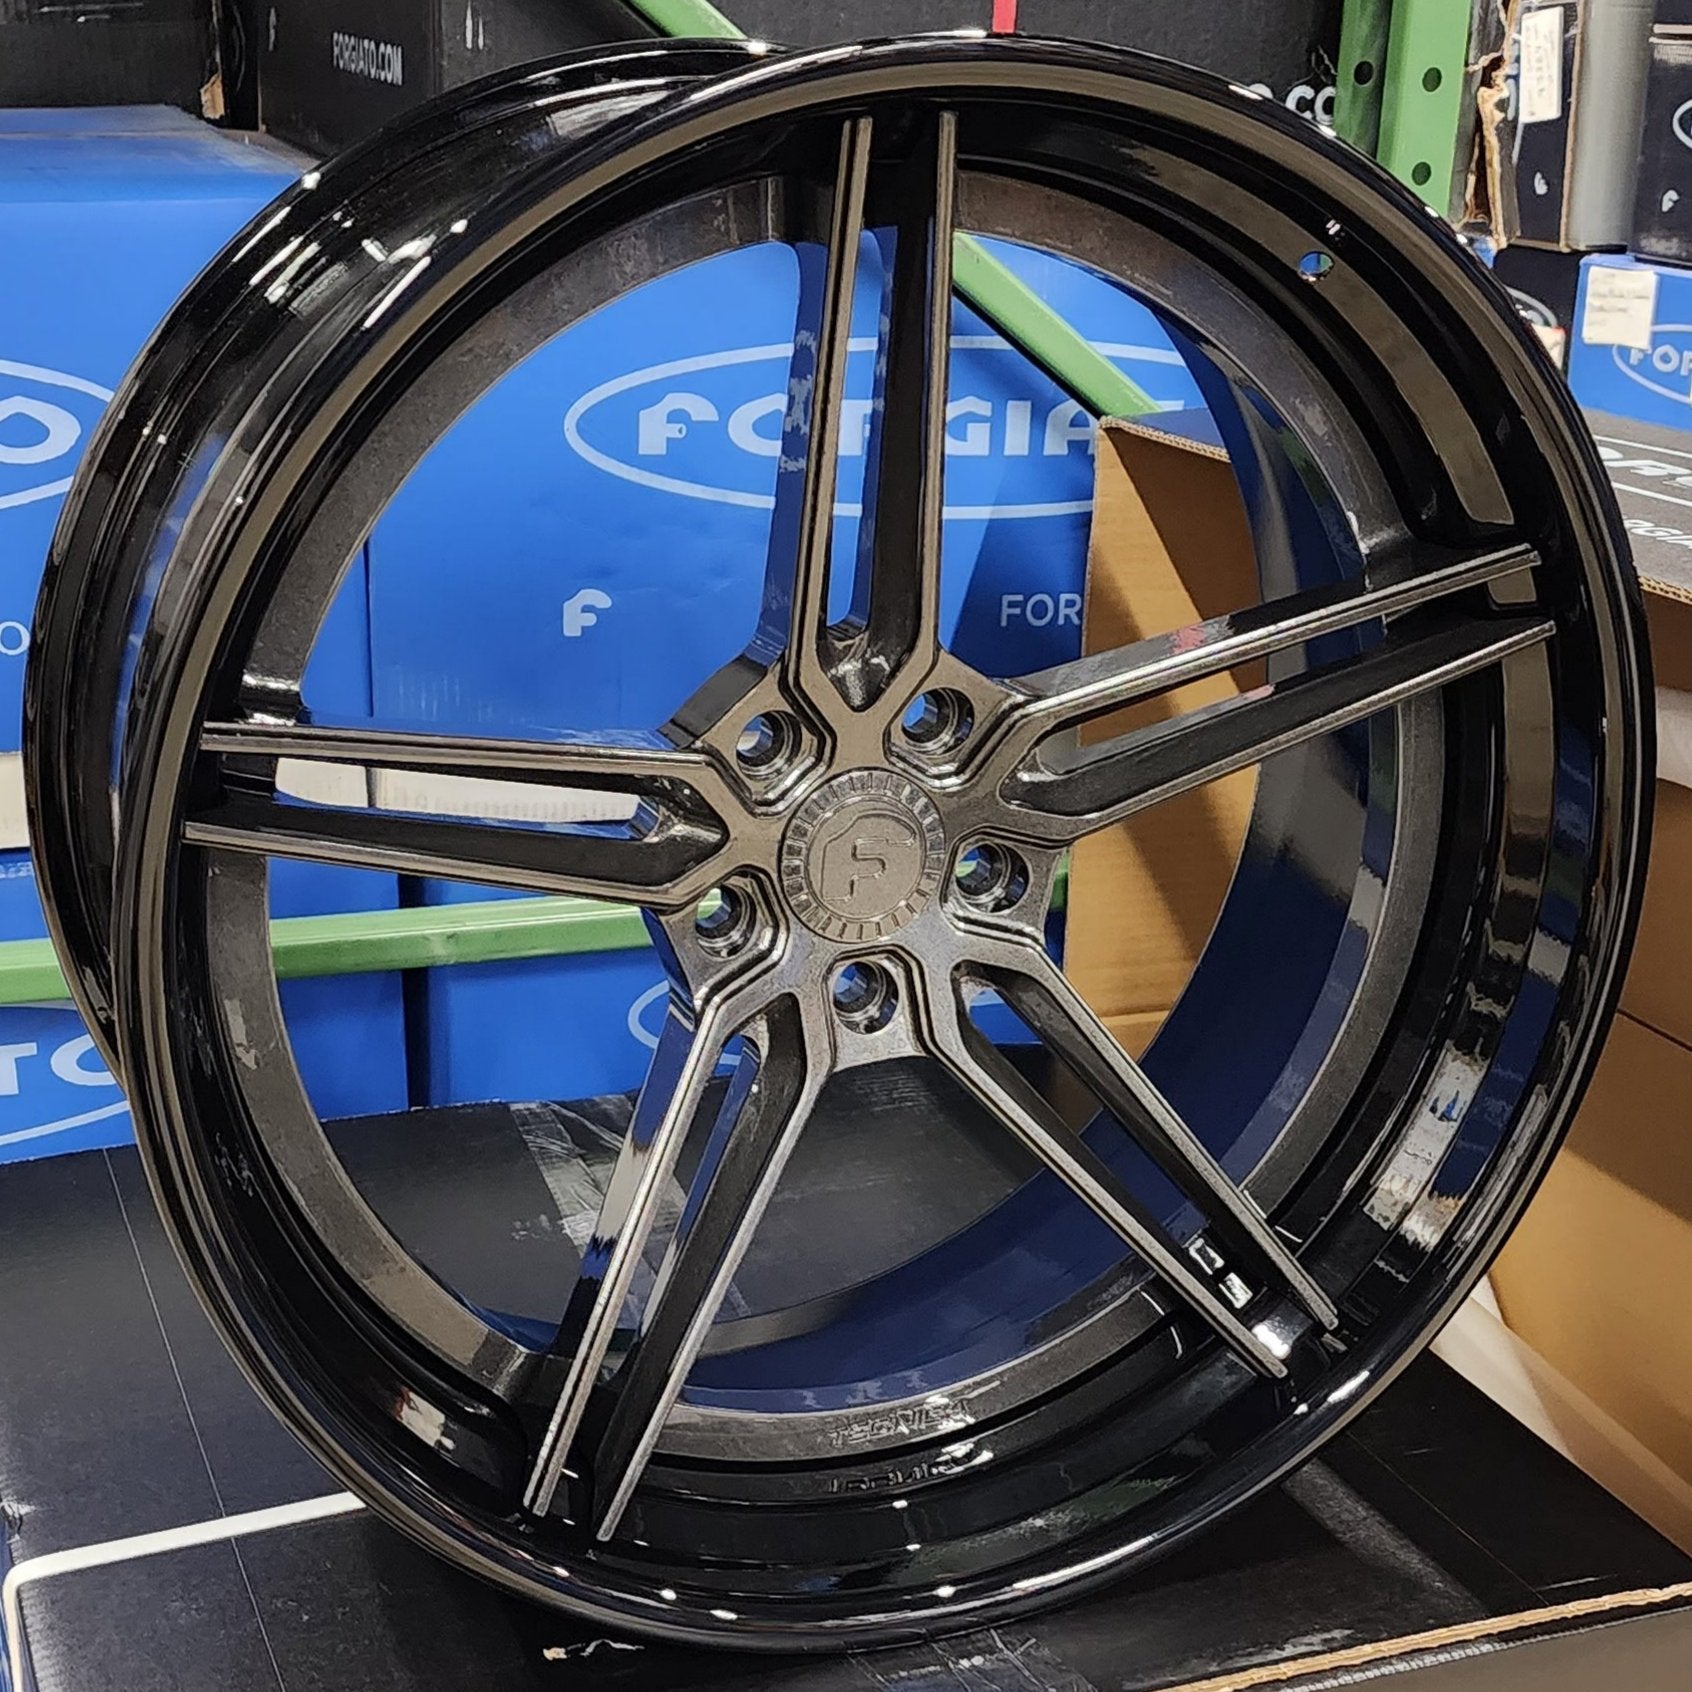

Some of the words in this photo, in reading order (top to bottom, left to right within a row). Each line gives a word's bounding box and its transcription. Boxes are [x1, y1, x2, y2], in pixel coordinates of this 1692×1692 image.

[332, 31, 403, 86] FORGIATO.COM
[563, 588, 613, 638] F
[1000, 593, 1082, 627] FOR
